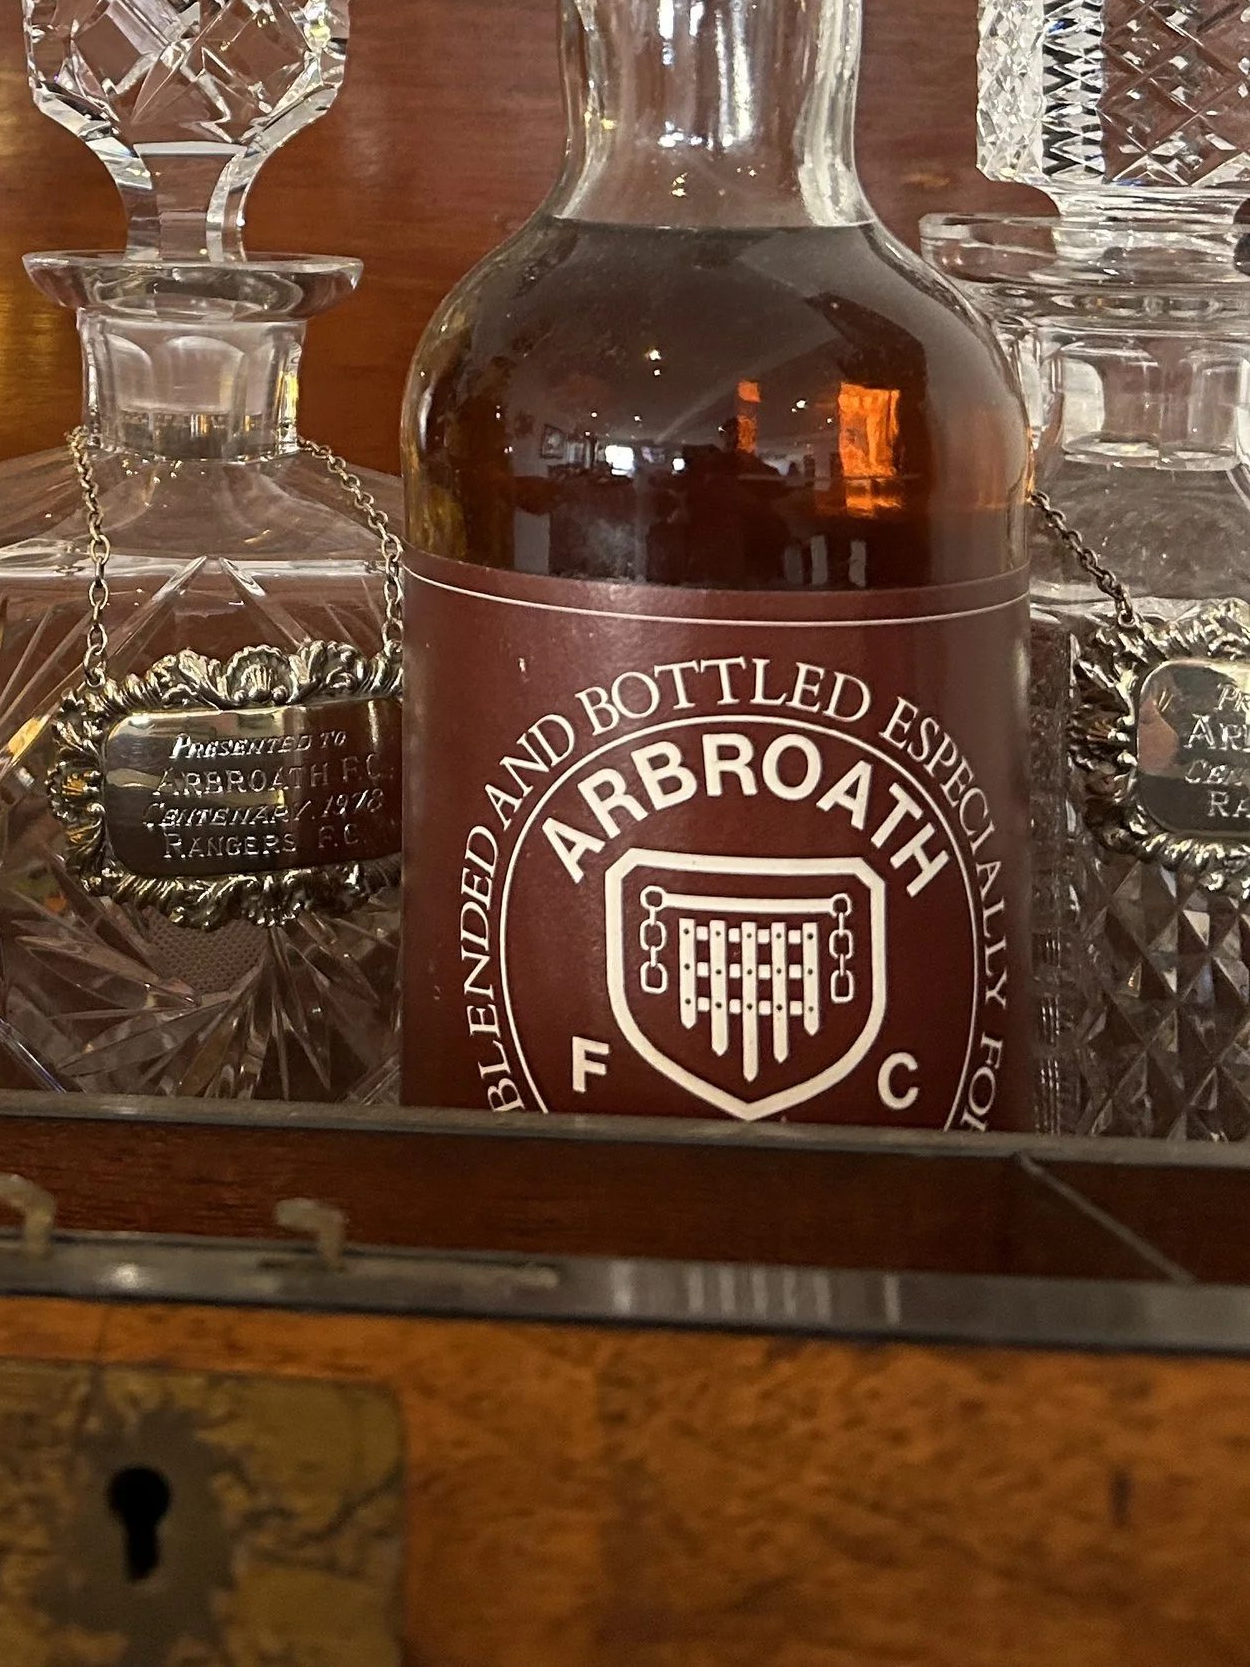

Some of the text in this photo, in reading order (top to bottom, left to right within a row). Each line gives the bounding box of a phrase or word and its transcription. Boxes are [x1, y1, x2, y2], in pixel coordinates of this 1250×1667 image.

[574, 656, 872, 737] BOTTLED
[152, 763, 330, 797] ARBROATH
[169, 730, 346, 760] PRESENTED TO
[484, 714, 576, 832] AND
[163, 832, 298, 860] RANGERS
[541, 733, 949, 899] ARBROATH
[879, 696, 1008, 1010] ESPECIALLY
[459, 825, 526, 1113] BLENDED
[571, 1035, 920, 1111] F C
